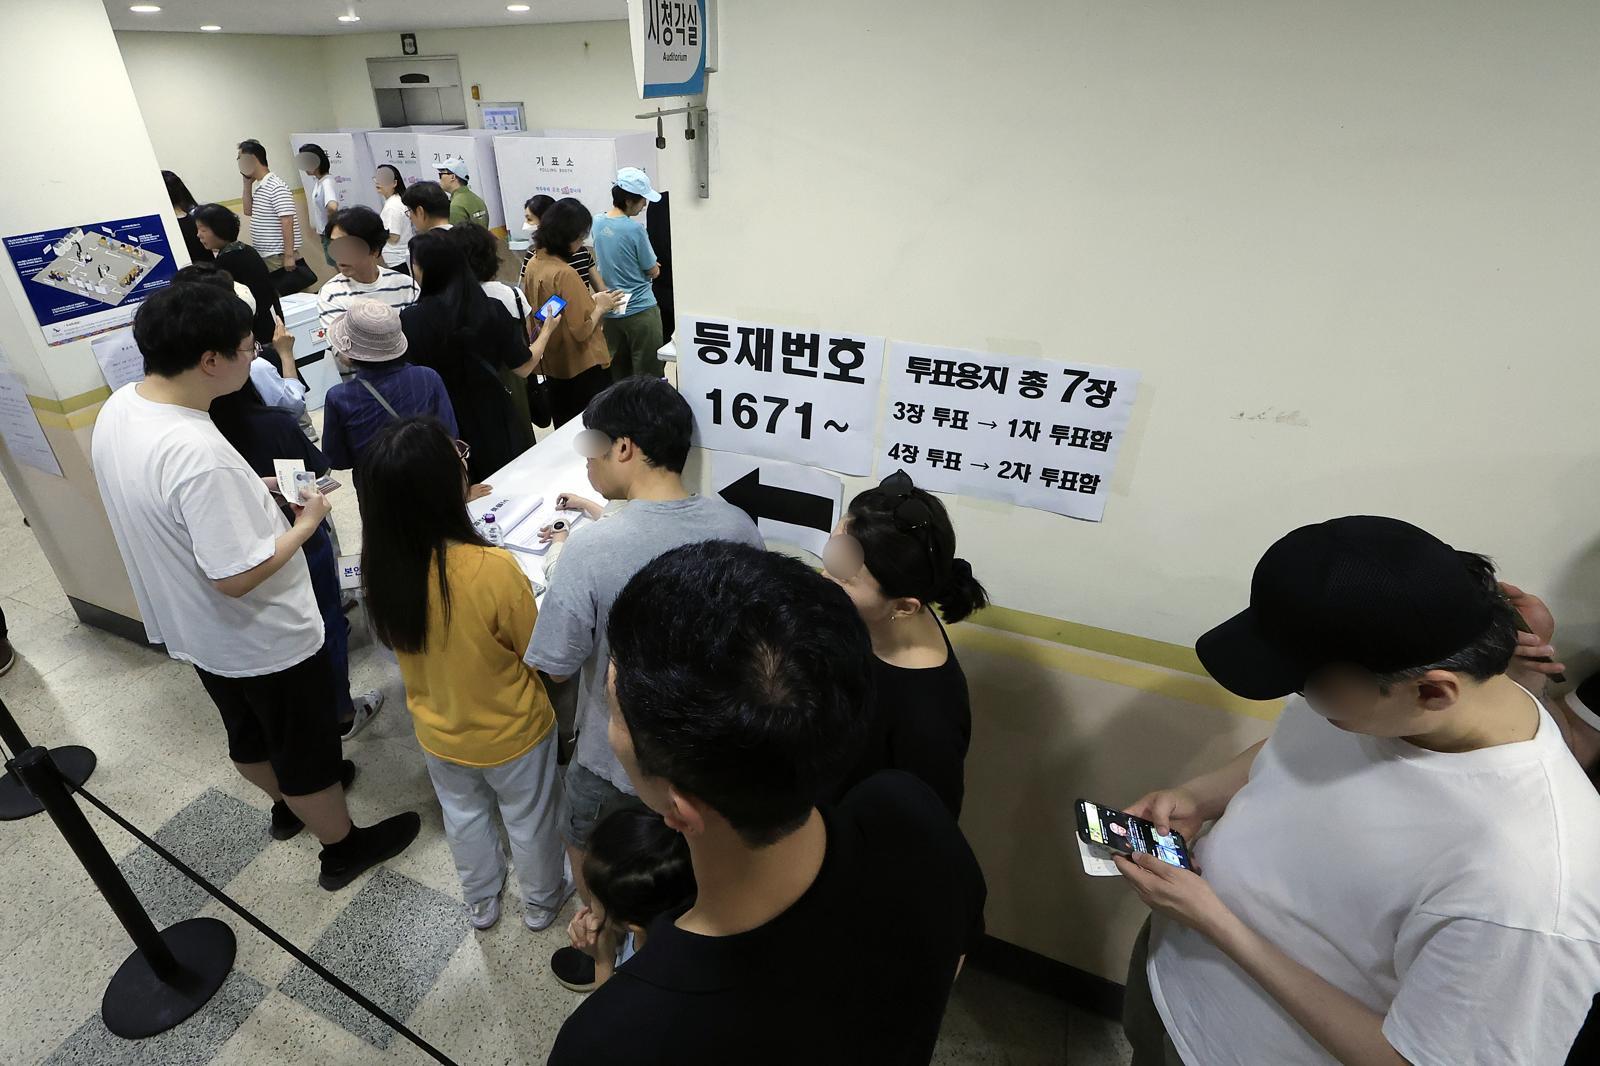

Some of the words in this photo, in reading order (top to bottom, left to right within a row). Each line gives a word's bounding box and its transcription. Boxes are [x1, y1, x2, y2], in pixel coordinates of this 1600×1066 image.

[648, 0, 697, 46] 시청각실
[663, 52, 687, 61] Auditorium
[693, 321, 866, 384] 등재번호
[905, 356, 1009, 394] 투표용지
[1018, 370, 1048, 399] 총
[1060, 368, 1118, 409] 7장
[706, 388, 849, 440] 1671~
[893, 401, 925, 424] 3장
[932, 407, 969, 430] 투표
[1008, 419, 1041, 442] 1차
[1049, 424, 1113, 452] 투표함
[888, 442, 919, 464] 4장
[926, 448, 962, 471] 투표
[997, 460, 1032, 483] 2차
[1039, 467, 1101, 495] 투표함
